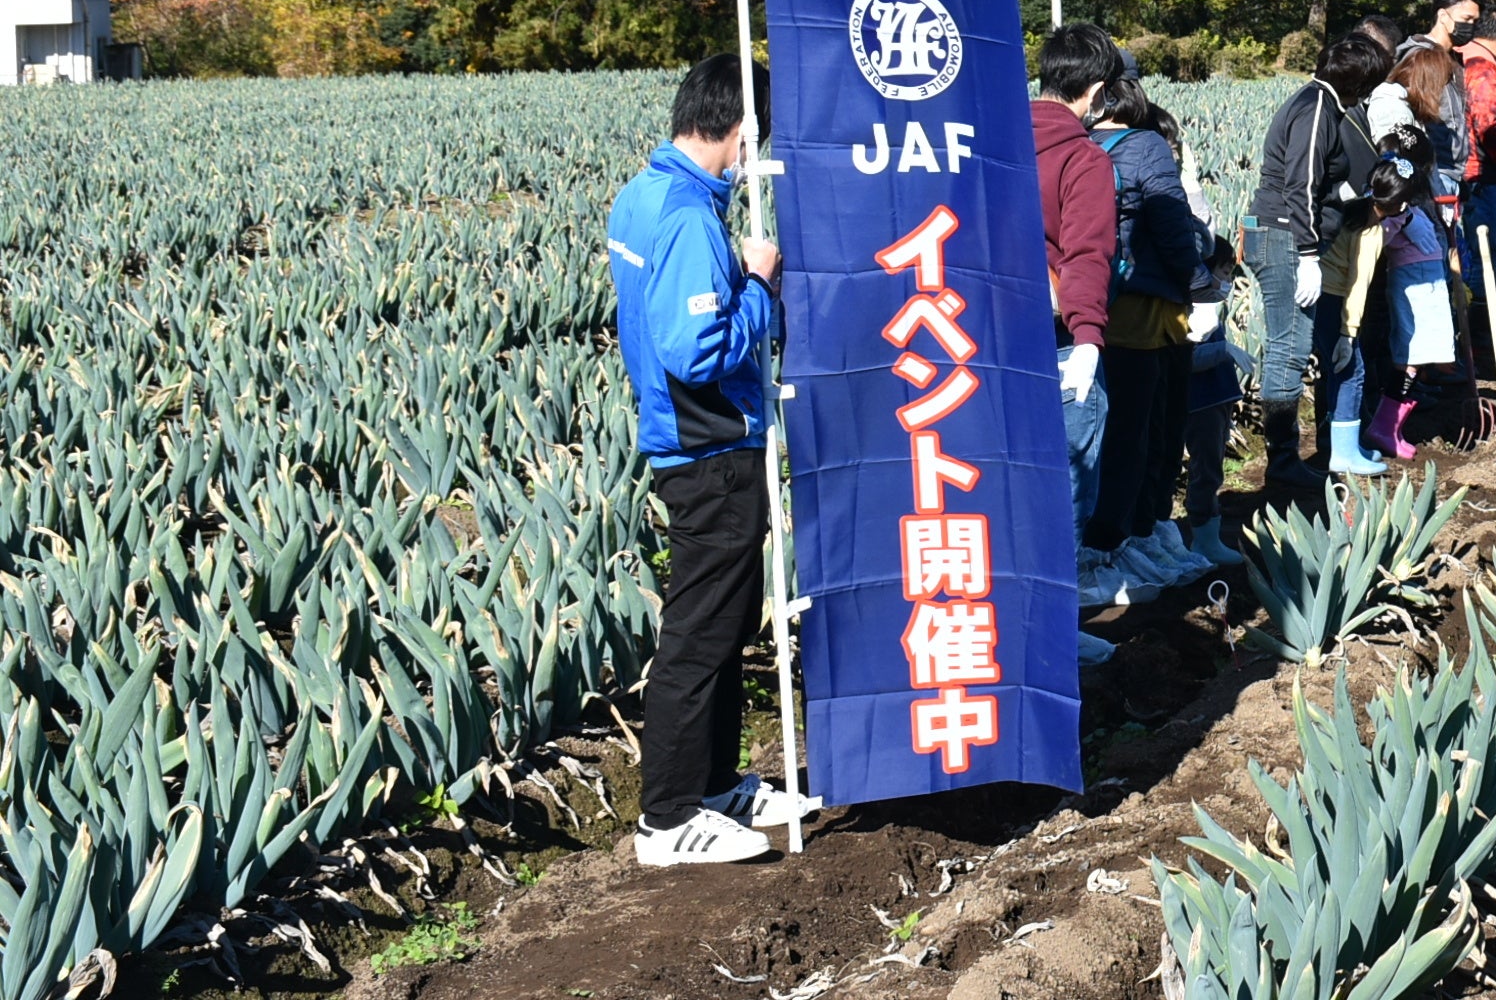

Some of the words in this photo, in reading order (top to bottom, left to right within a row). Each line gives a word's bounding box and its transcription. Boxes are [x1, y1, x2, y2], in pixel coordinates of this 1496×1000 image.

[851, 6, 900, 97] FEDERATION
[918, 12, 961, 97] AUTOMOBILE
[852, 121, 975, 175] JAF
[874, 204, 1001, 774] イベント開催中
